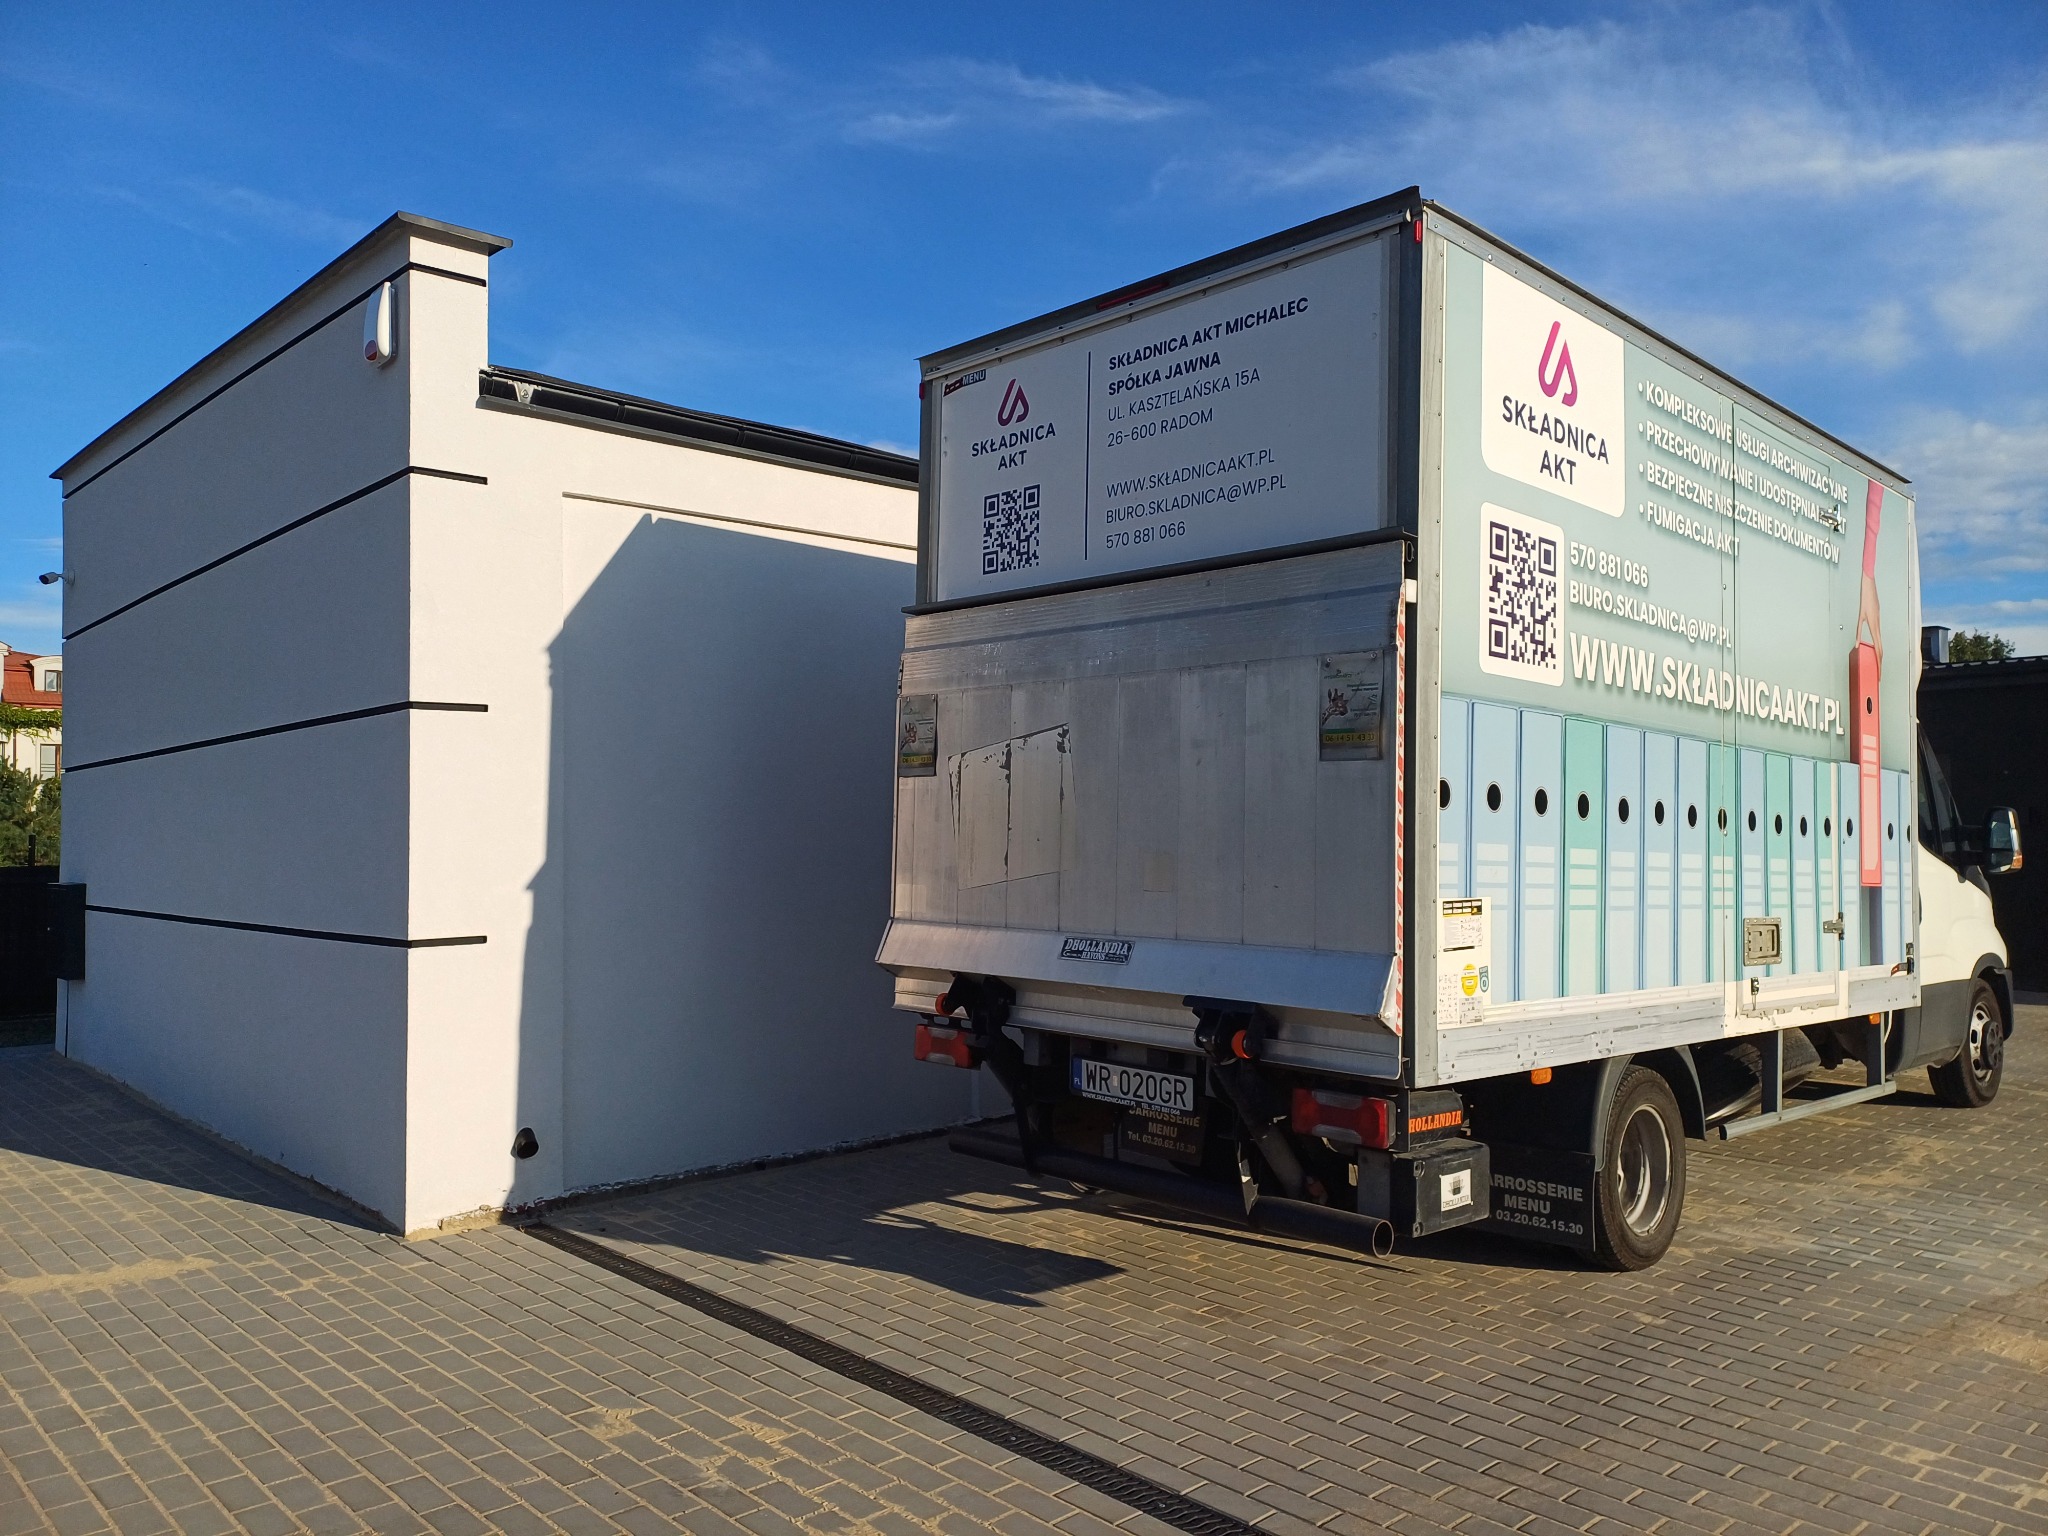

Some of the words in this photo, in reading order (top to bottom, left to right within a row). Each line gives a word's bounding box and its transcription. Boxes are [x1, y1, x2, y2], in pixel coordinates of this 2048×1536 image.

[1109, 335, 1188, 370] SKŁADNICA
[1192, 324, 1222, 346] AKT
[1226, 297, 1309, 335] MICHALEC
[962, 370, 985, 385] MENU
[1108, 369, 1161, 396] SPÓŁKA
[1165, 352, 1221, 380] JAWNA
[1108, 406, 1125, 422] UL.
[1129, 376, 1230, 416] KASZTELAŃSKA
[1236, 368, 1260, 388] 15A
[972, 422, 1056, 457] SKŁADNICA
[1108, 422, 1156, 448] 26-600
[1160, 408, 1214, 434] RADOM
[1502, 395, 1609, 464] SKŁADNICA
[1646, 380, 1732, 444] KOMPLEKSOWE
[1736, 428, 1770, 464] USŁUGI
[1771, 448, 1848, 504] ARCHIWIZACYJNE
[998, 450, 1027, 470] AKT
[1106, 448, 1274, 498] WWW.SKŁADNICAAKT.PL
[1540, 450, 1576, 485] AKT
[1646, 420, 1754, 490] PRZECHOWYWANIE
[1754, 474, 1758, 492] I
[1106, 474, 1286, 524] BIURO.SKLADNICA@WP.PL
[1647, 460, 1714, 510] BEZPIECZNE
[1715, 492, 1773, 535] NISZCZENIE
[1774, 518, 1840, 564] DOKUMENTÓW
[1106, 532, 1130, 548] 570
[1134, 527, 1155, 544] 881
[1160, 521, 1186, 539] 066
[1647, 500, 1715, 548] FUMIGACJA
[1716, 532, 1740, 556] AKT
[1570, 541, 1596, 570] 570
[1599, 551, 1621, 580] 881
[1624, 560, 1649, 588] 066
[1570, 580, 1732, 648] BIURO.SKLADNICA@WP.PL
[1570, 632, 1844, 735] WWW.SKŁADNICAAKT.PL
[1065, 939, 1128, 955] DHOLLANDIA
[1074, 1077, 1080, 1085] PL
[1086, 1062, 1111, 1094] WR
[1120, 1069, 1186, 1108] 020GR
[1128, 1131, 1140, 1142] Tel.
[1148, 1122, 1178, 1138] MENU
[1409, 1110, 1462, 1134] HOLLANDIA
[1496, 1209, 1584, 1236] 03.20.62.15.30
[1504, 1194, 1550, 1214] MENU
